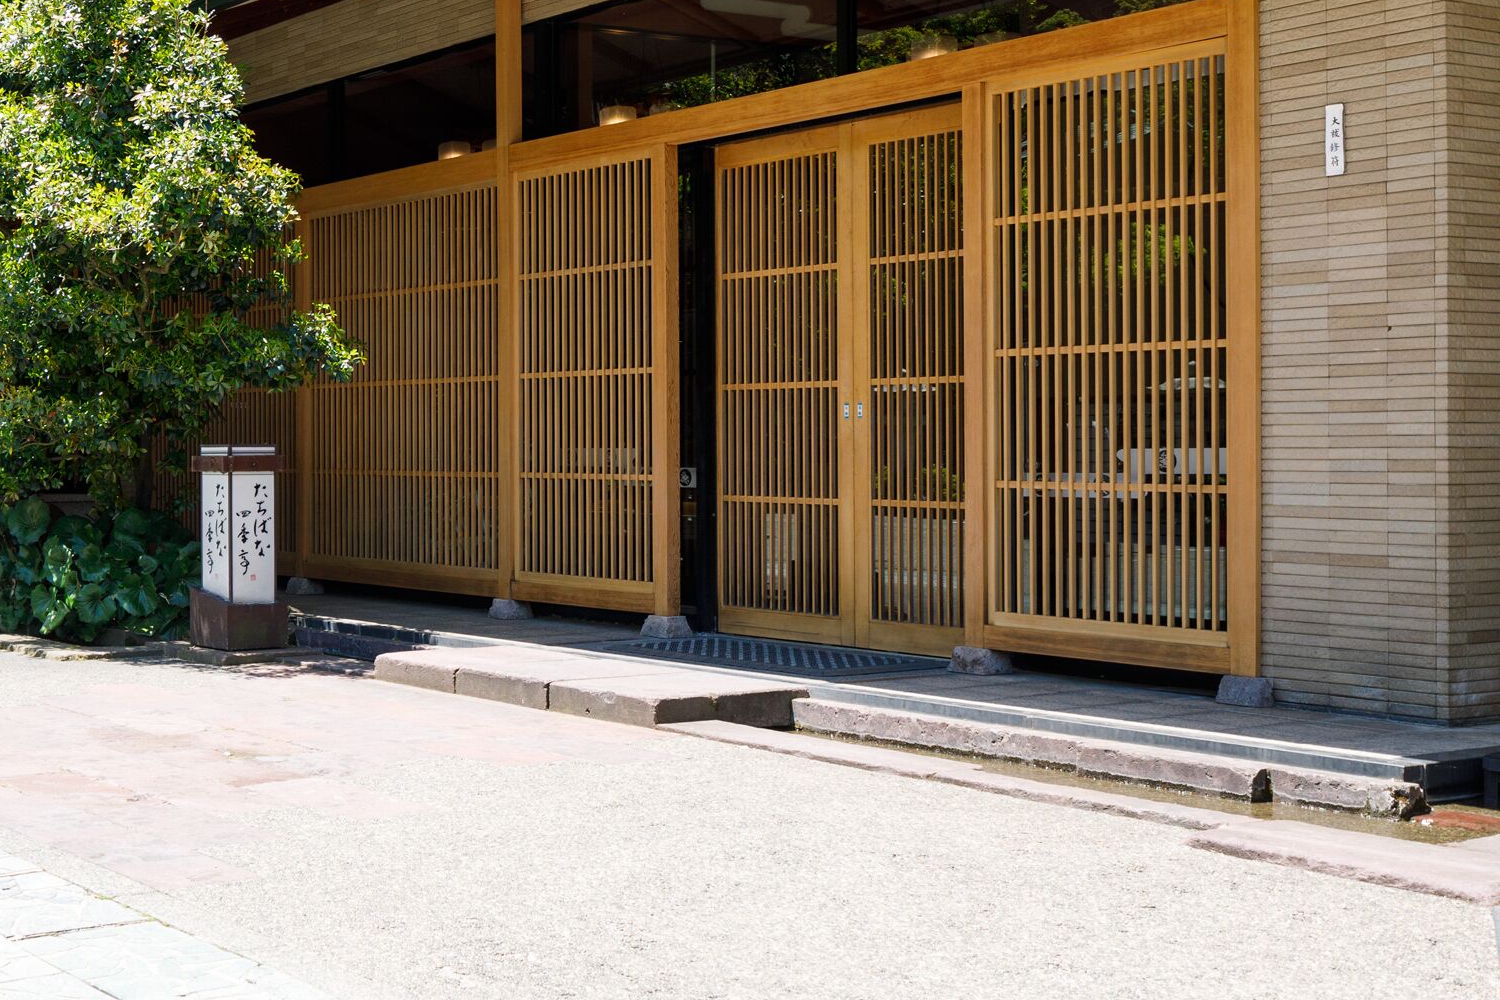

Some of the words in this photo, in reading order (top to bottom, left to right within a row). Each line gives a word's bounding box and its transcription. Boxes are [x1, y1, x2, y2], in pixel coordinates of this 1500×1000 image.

[204, 509, 215, 574] 四季亭
[215, 483, 227, 557] たちばな
[236, 509, 252, 576] 四季亭
[253, 483, 272, 557] たちばな
